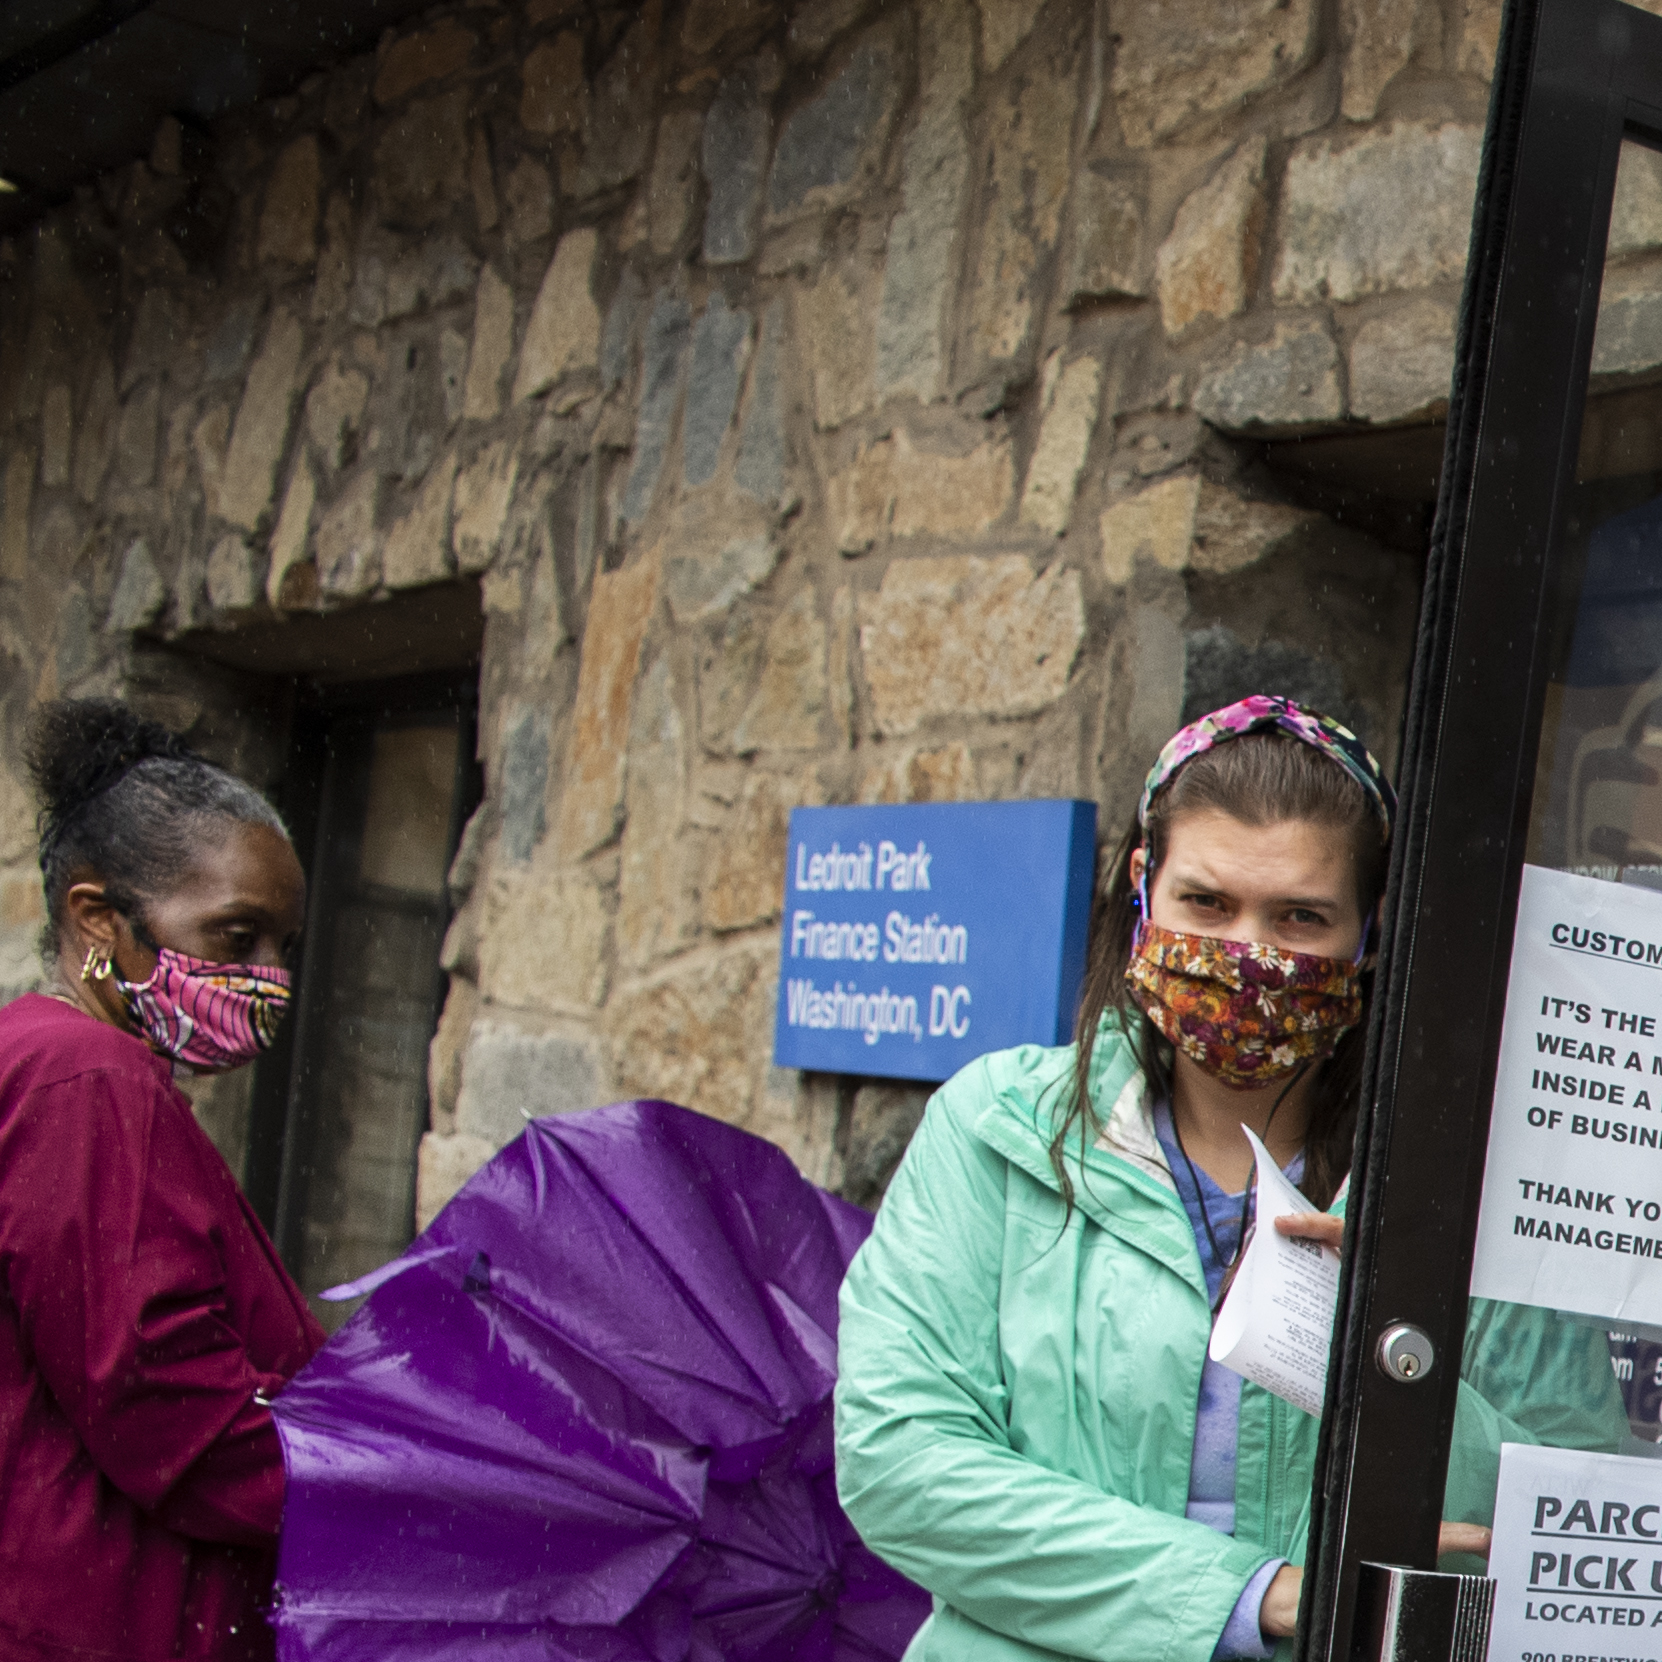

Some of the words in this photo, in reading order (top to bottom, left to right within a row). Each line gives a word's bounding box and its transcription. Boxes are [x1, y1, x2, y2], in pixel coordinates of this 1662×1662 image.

[796, 842, 872, 891] Ledroit
[876, 840, 932, 891] Park
[791, 910, 880, 962] Finance
[883, 911, 968, 964] Station
[788, 978, 922, 1045] Washington,
[929, 985, 971, 1038] DC
[1540, 996, 1591, 1024] IT'S
[1601, 1008, 1656, 1037] THE
[1536, 1032, 1616, 1066] WEAR
[1624, 1052, 1642, 1072] A
[1532, 1069, 1625, 1105] INSIDE
[1633, 1090, 1652, 1110] A
[1527, 1107, 1563, 1130] OF
[1518, 1179, 1616, 1214] THANK
[1529, 1552, 1638, 1592] PICK
[1525, 1602, 1645, 1627] LOCATED
